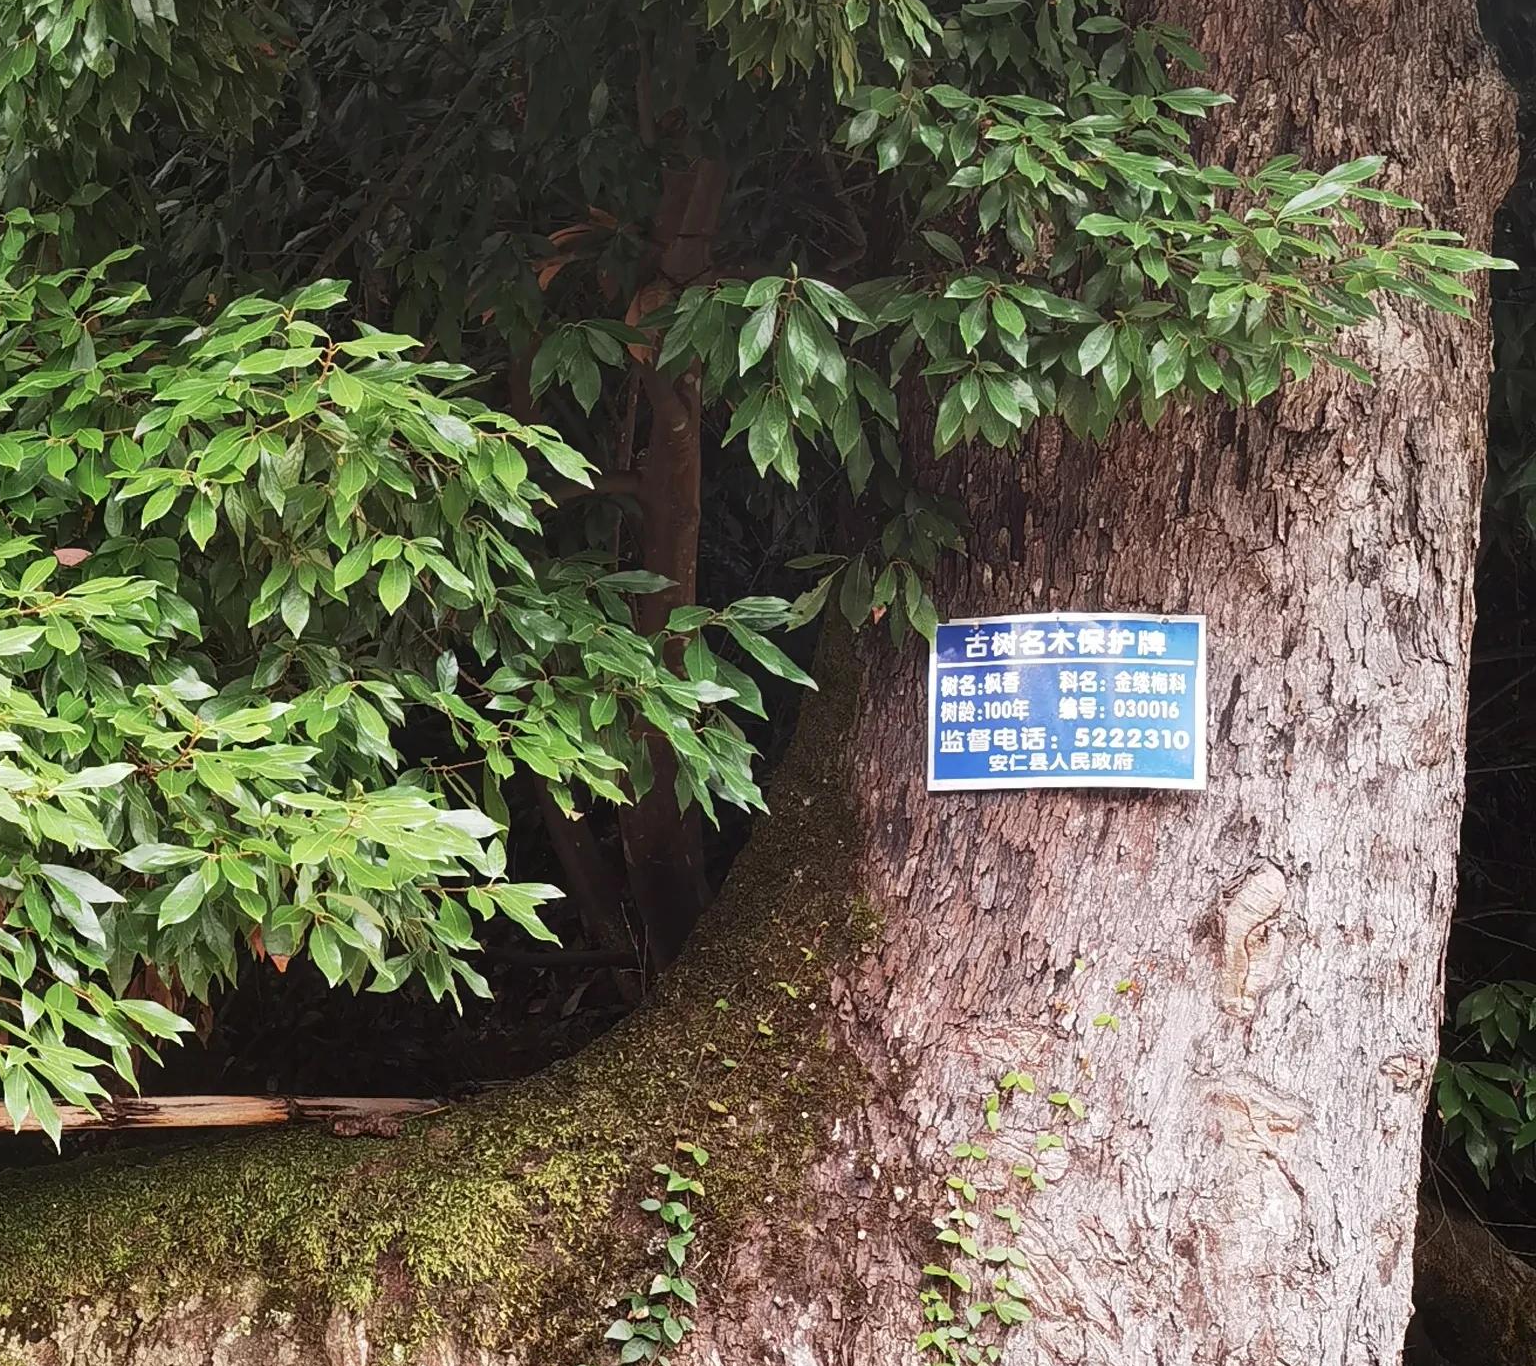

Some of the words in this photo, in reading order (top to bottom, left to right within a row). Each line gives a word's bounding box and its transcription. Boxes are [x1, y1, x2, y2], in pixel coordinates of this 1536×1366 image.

[964, 629, 1167, 658] 古树名木保护牌
[988, 753, 1134, 772] 安仁县人民政府
